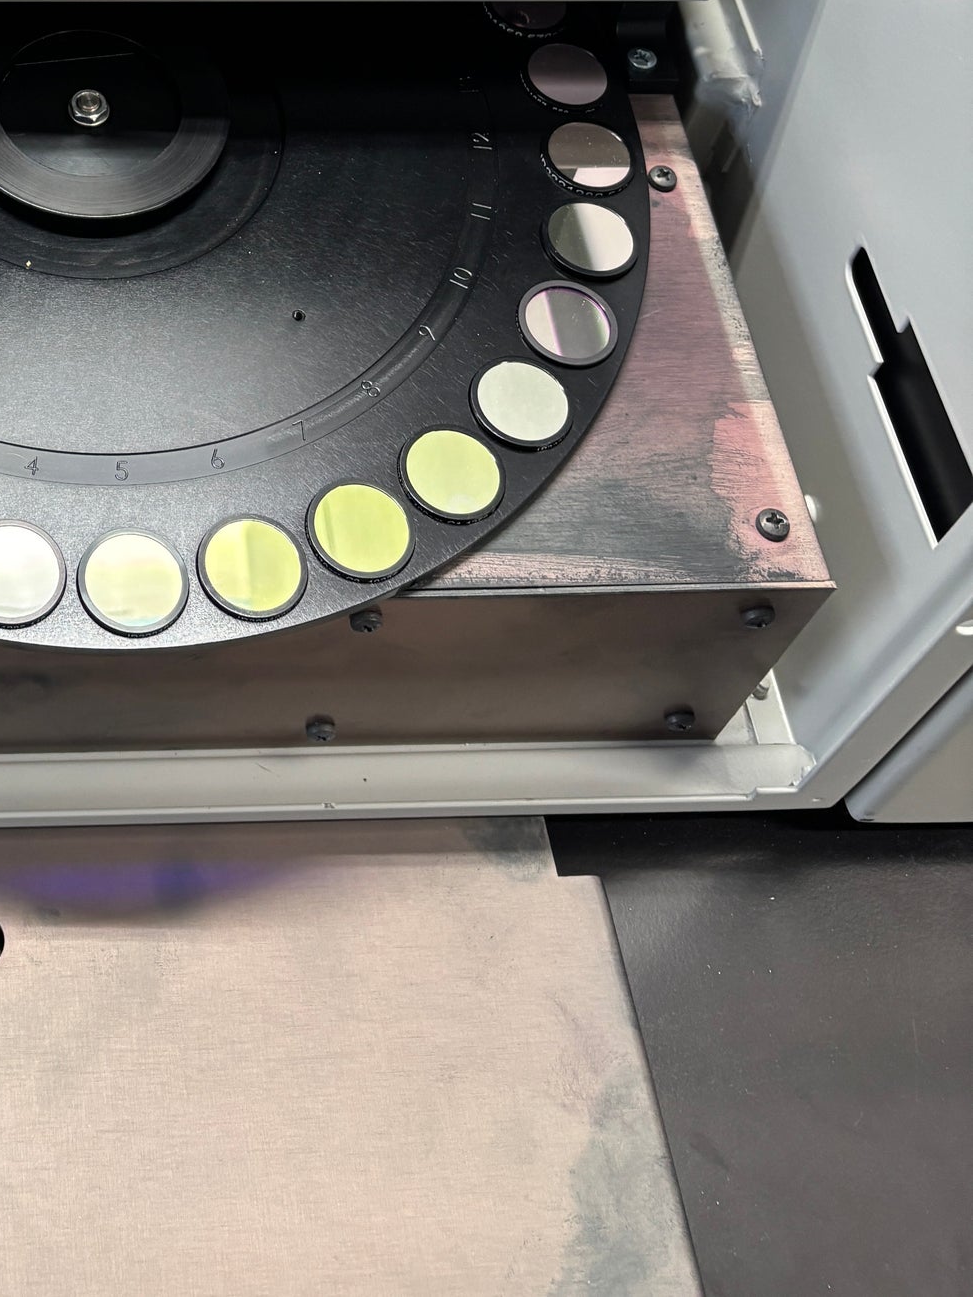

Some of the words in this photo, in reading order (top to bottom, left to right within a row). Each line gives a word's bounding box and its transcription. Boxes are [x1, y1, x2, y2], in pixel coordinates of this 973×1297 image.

[449, 267, 473, 289] 10
[418, 324, 436, 341] 9
[360, 379, 381, 398] 8
[291, 419, 306, 442] 7
[23, 456, 39, 476] 4
[210, 448, 225, 470] 6
[114, 460, 129, 481] 5
